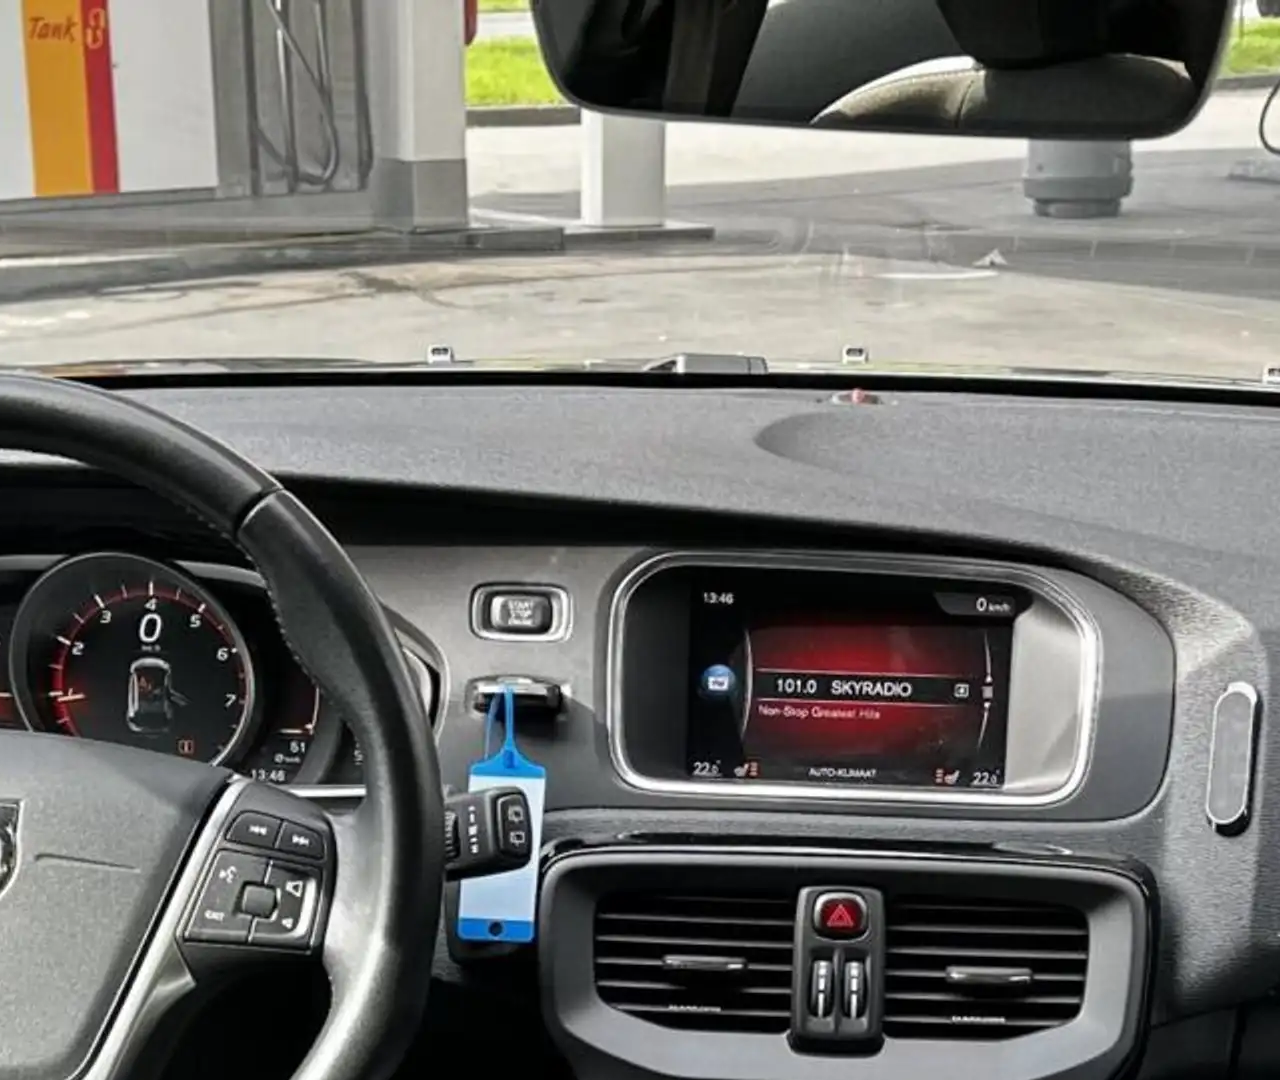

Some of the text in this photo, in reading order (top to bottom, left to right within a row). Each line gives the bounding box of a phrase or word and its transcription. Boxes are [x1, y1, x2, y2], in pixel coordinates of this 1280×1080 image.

[28, 16, 78, 43] Tank
[145, 598, 157, 611] 4
[703, 592, 734, 604] 13:46
[976, 598, 987, 611] 0
[100, 611, 112, 624] 3
[190, 615, 201, 628] 5
[139, 613, 162, 643] 0
[72, 643, 85, 656] 2
[216, 648, 229, 661] 6
[777, 679, 913, 697] 101.0 SKYRADIO
[225, 694, 237, 708] 7
[758, 705, 810, 719] Non-Stop
[811, 706, 857, 719] Greatest
[251, 768, 286, 781] 13:46
[808, 766, 877, 778] AUTO-KLIMAAT
